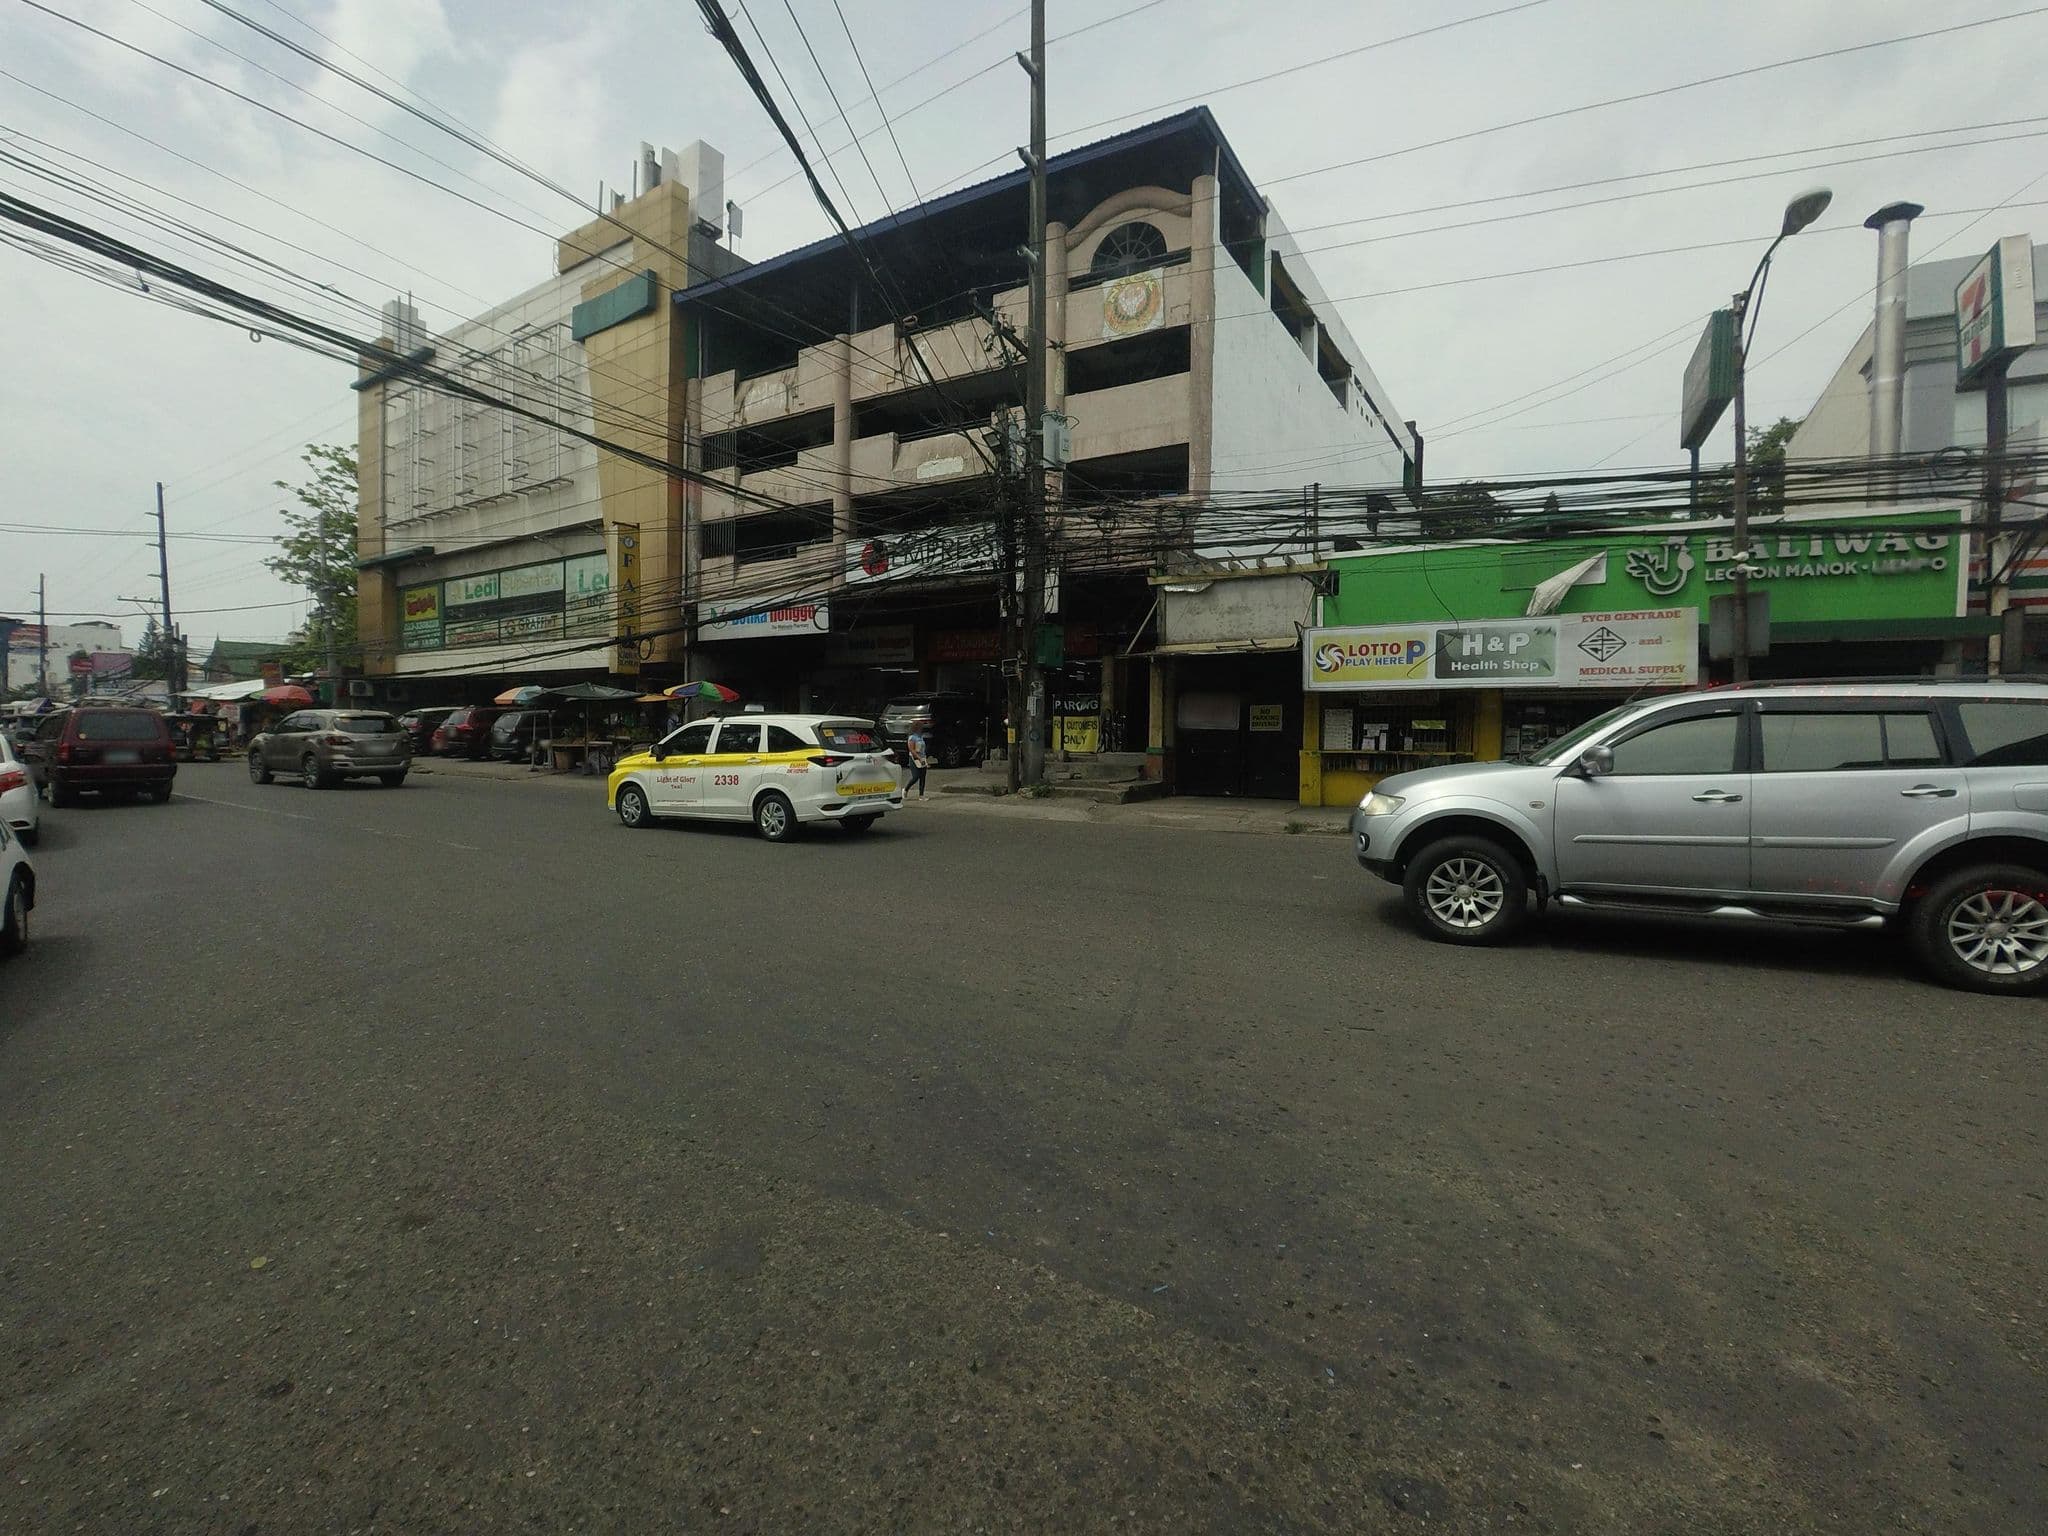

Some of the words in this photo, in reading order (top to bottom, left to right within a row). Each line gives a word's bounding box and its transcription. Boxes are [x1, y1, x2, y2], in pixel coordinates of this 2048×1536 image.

[1705, 566, 1780, 583] LECON
[1785, 561, 1858, 578] MANOK
[1613, 610, 1682, 622] GENTRADE
[1462, 633, 1483, 656] H
[1486, 636, 1504, 652] &
[1508, 632, 1530, 655] P
[1638, 636, 1663, 645] and
[1348, 642, 1402, 657] LOTTO
[1345, 656, 1372, 667] PLAY
[1374, 655, 1405, 666] HERE
[1451, 659, 1498, 672] Health
[1503, 659, 1539, 672] Shop
[1578, 666, 1633, 676] MEDICAL
[1637, 664, 1686, 674] SUPPLY
[1063, 735, 1087, 745] ONLY
[656, 775, 672, 784] Light
[680, 775, 697, 784] Glory
[714, 773, 740, 786] 2338
